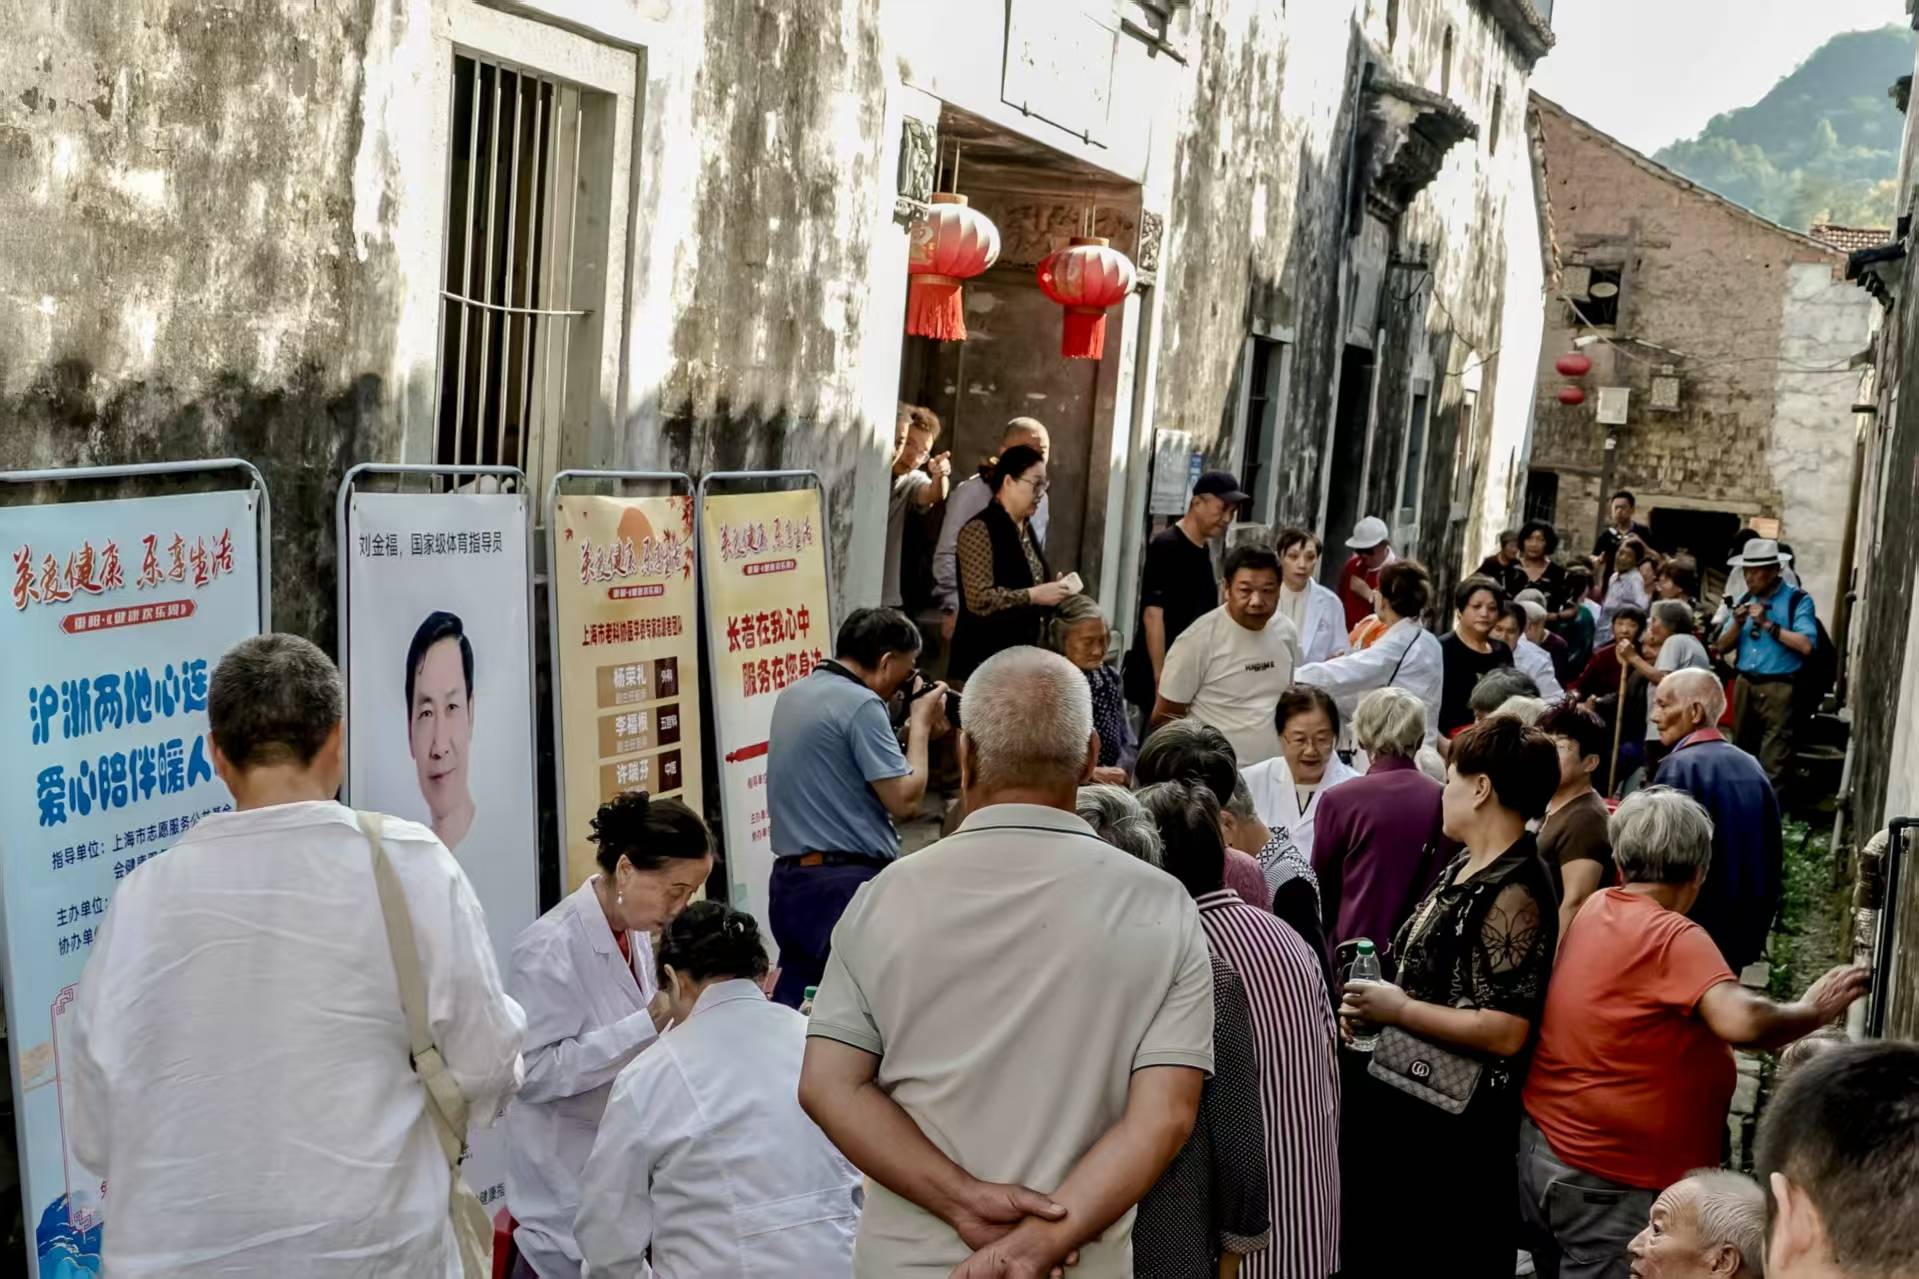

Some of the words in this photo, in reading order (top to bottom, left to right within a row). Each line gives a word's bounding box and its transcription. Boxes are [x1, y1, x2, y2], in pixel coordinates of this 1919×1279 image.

[12, 538, 124, 609] 关爱健康
[136, 528, 234, 587] 乐享生活
[727, 604, 810, 653] 长者在我心中
[29, 659, 208, 745] 沪浙两地心连
[37, 735, 217, 827] 爱心陪伴暖人
[58, 926, 99, 956] 协办单
